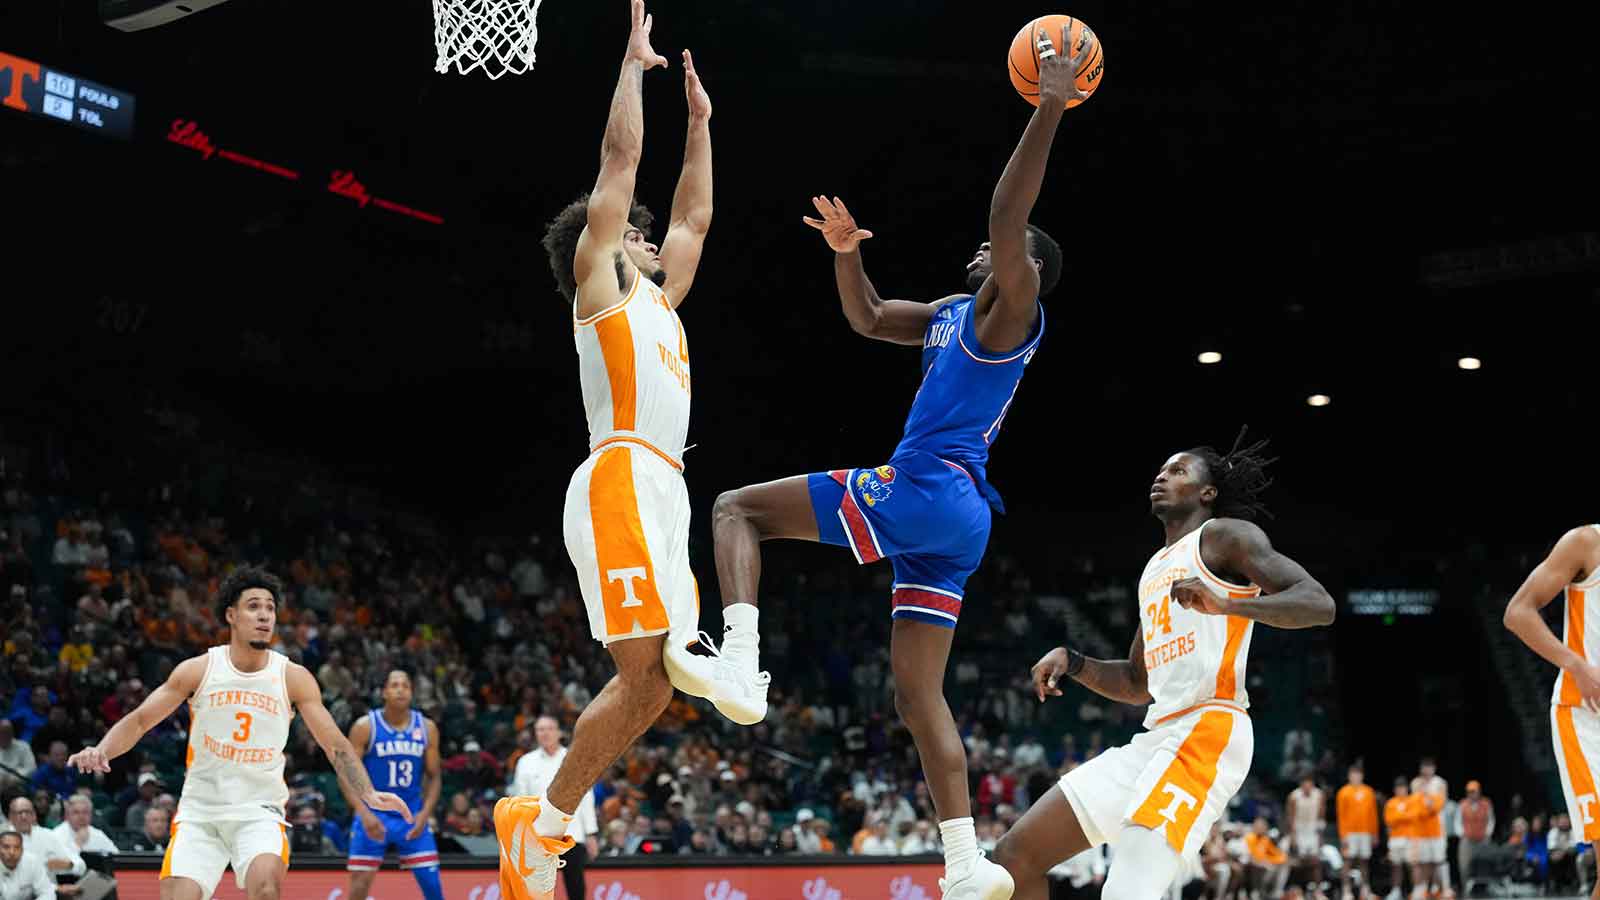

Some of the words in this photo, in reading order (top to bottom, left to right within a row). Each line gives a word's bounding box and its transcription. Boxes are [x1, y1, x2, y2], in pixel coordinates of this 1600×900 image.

[79, 86, 119, 109] FOULS
[78, 108, 104, 127] TOL
[606, 566, 648, 608] T
[1146, 594, 1172, 641] 34
[208, 690, 280, 716] TENNESSEE
[232, 711, 253, 743] 3
[203, 733, 274, 764] VOLUNTEERS
[375, 741, 424, 758] KANSAS
[387, 759, 414, 788] 13
[1158, 781, 1198, 824] T
